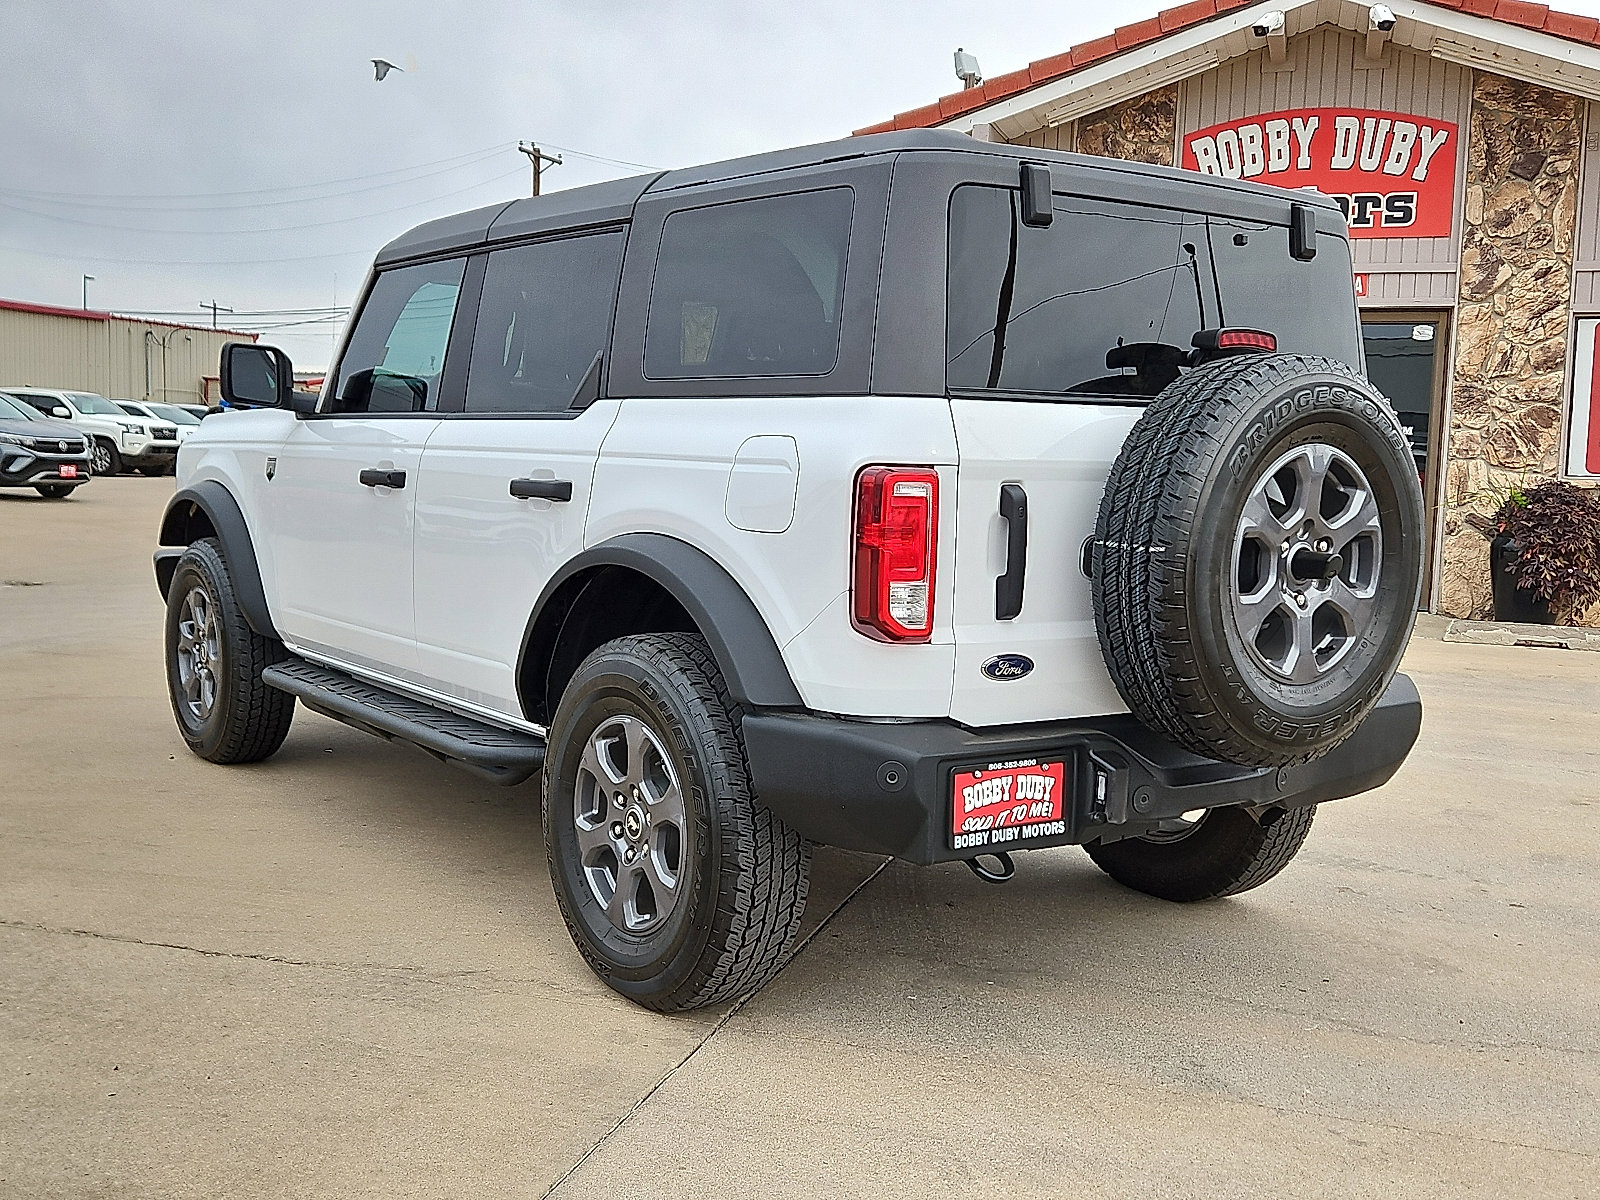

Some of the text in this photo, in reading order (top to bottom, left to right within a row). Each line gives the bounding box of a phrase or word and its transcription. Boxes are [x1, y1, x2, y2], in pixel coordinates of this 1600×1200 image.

[1190, 116, 1449, 181] BOBBY DUBY
[1229, 386, 1404, 477] BRIDGESTONE
[995, 660, 1024, 676] Ford
[962, 774, 1056, 813] BOBBY DUBY
[961, 801, 1054, 832] SOLD IT TO ME!
[954, 820, 1066, 850] BOBBY DUBY MOTORS
